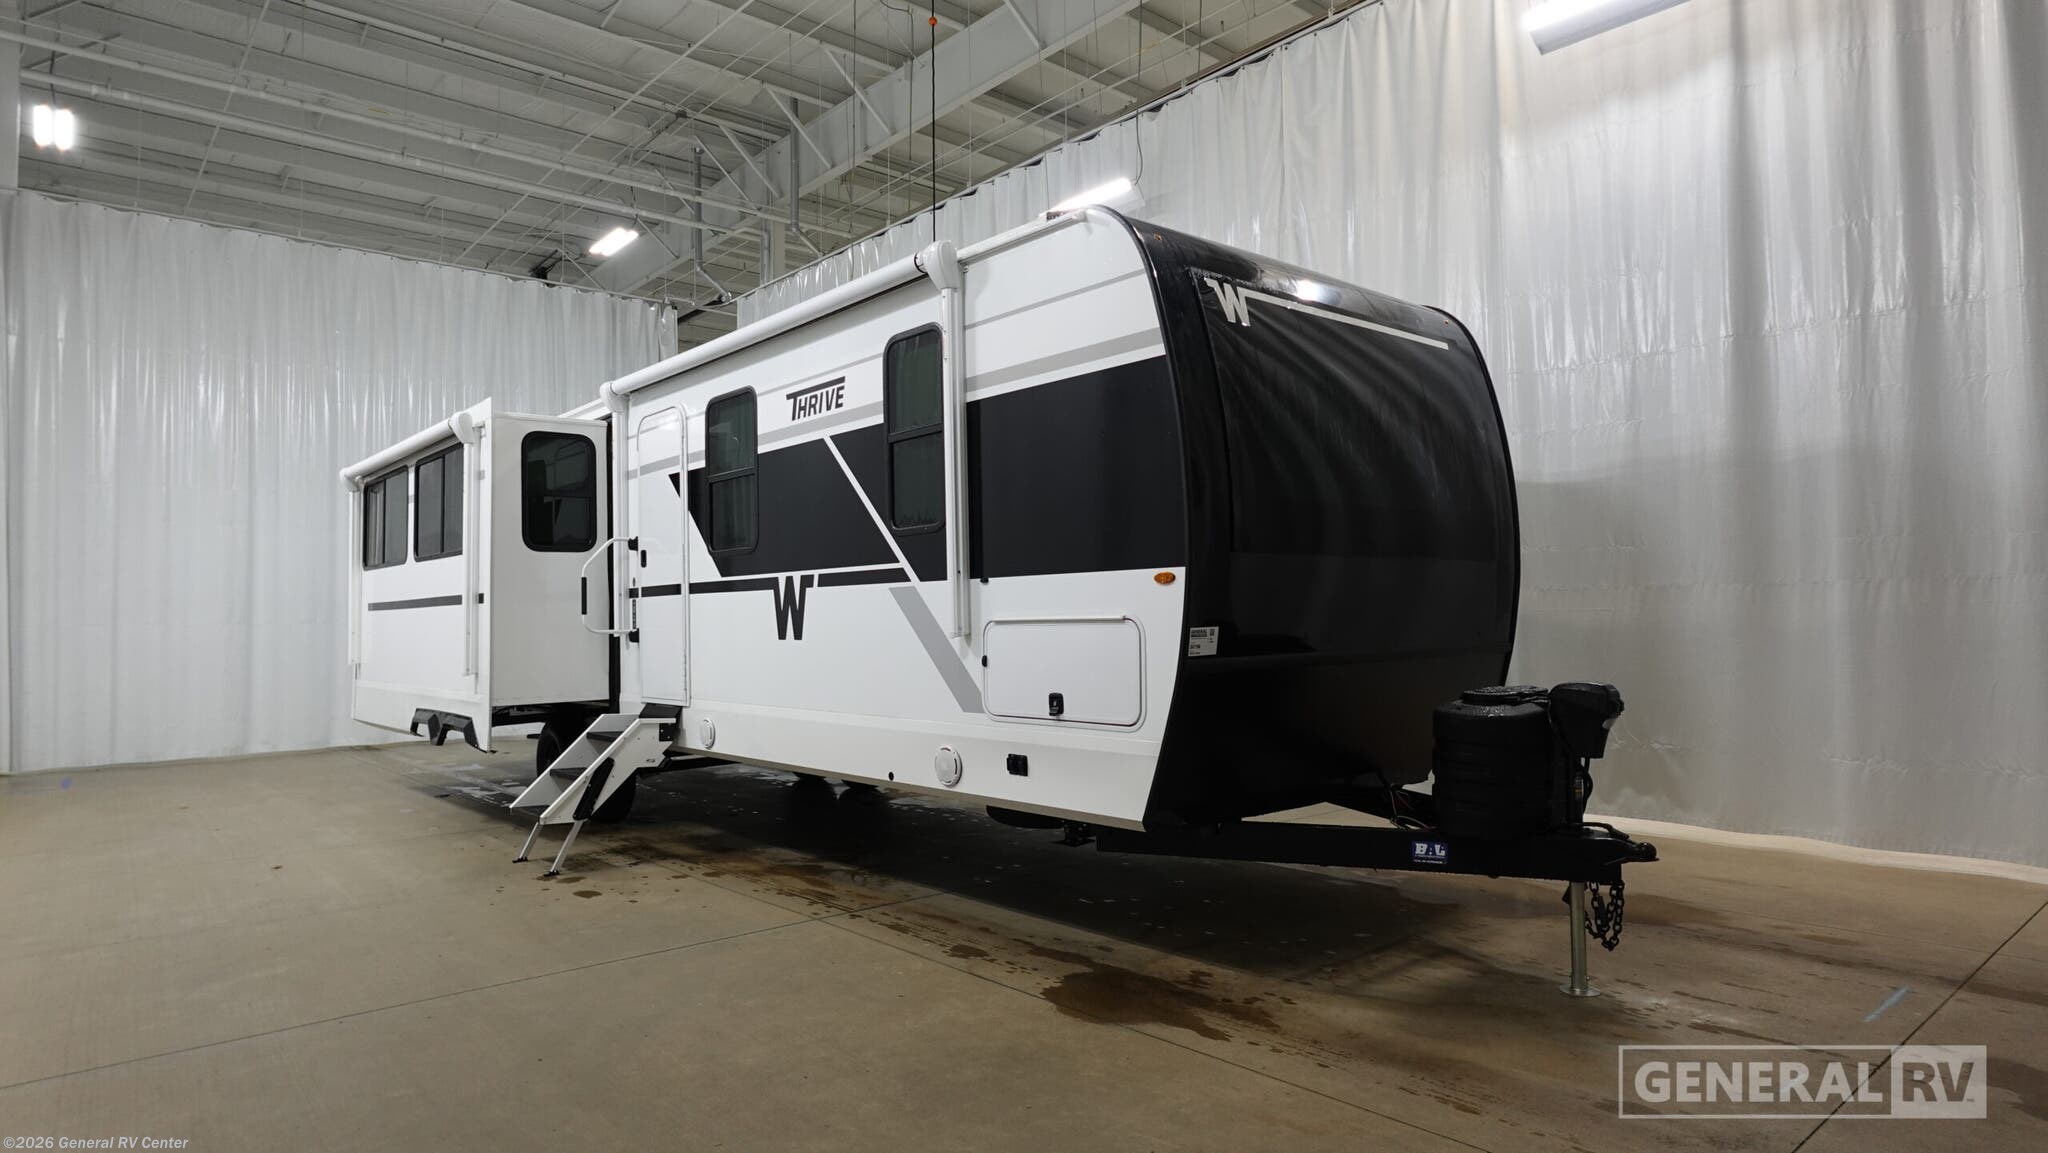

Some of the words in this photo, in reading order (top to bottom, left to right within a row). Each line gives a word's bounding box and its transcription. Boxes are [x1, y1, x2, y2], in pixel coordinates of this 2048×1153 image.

[1203, 276, 1251, 327] W
[785, 375, 846, 421] THRIVE
[771, 574, 815, 641] W
